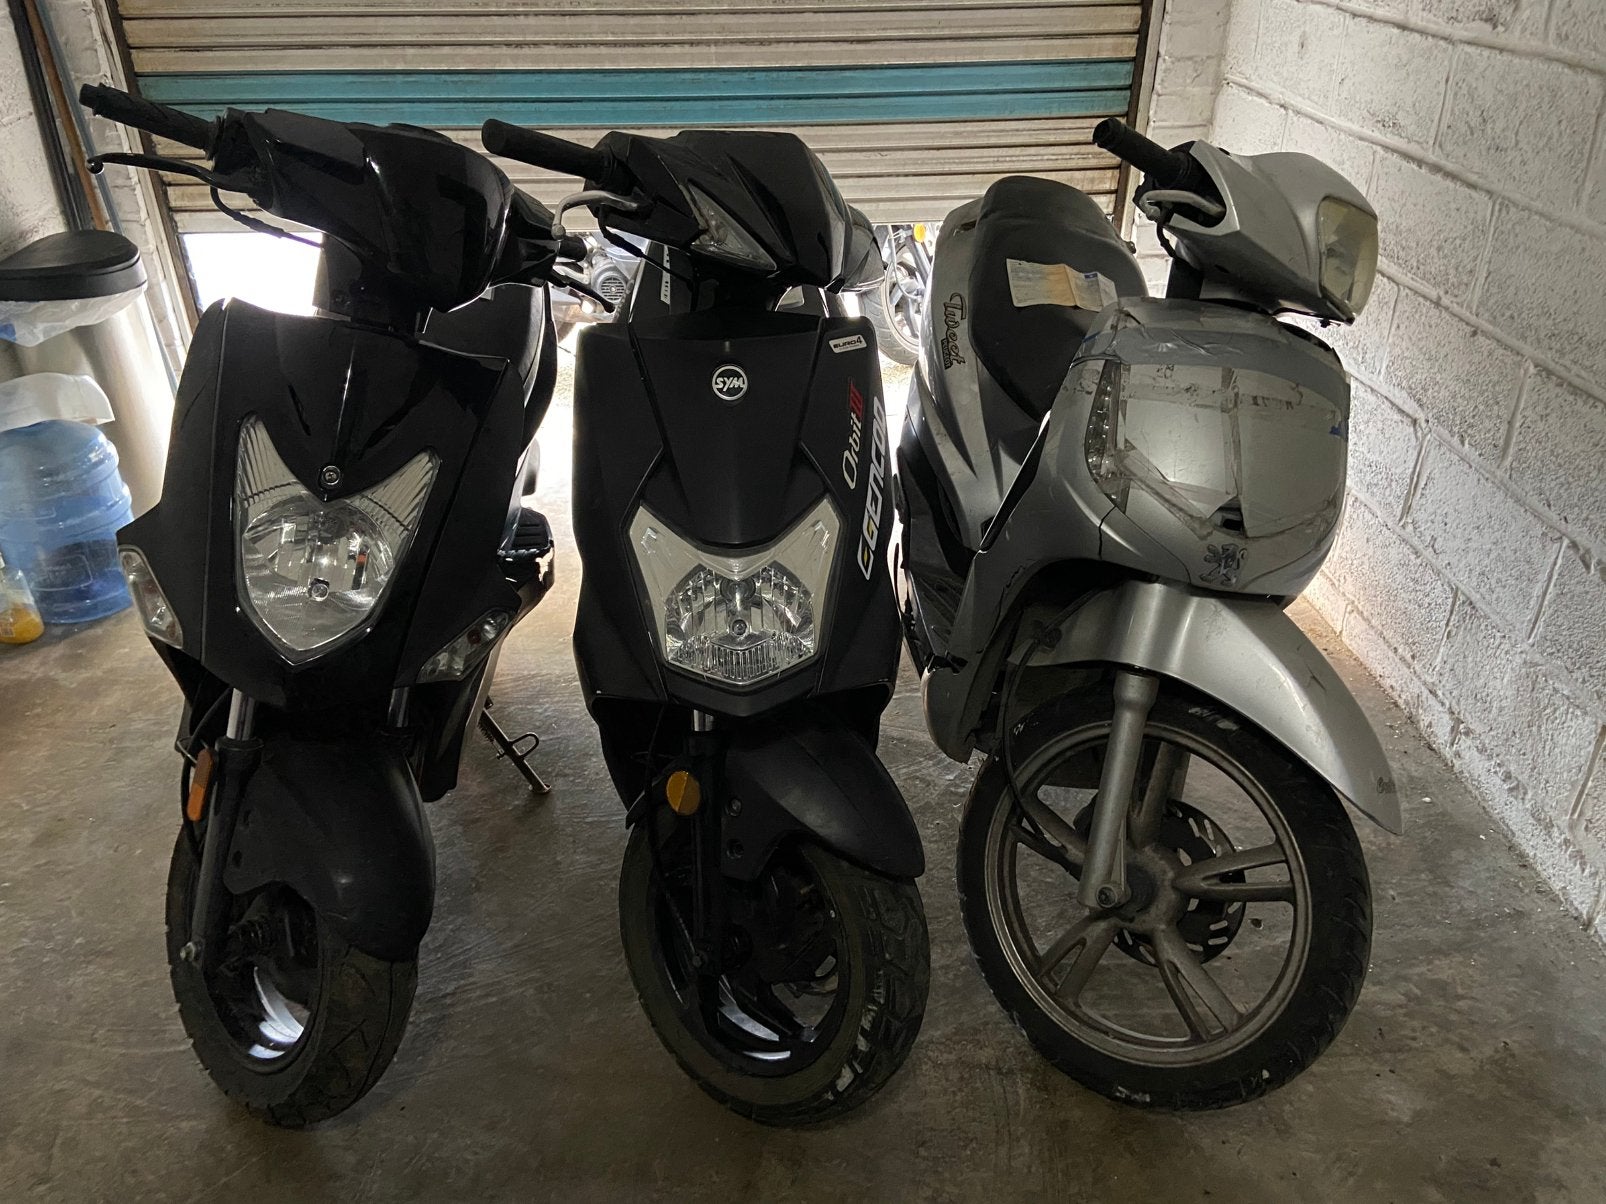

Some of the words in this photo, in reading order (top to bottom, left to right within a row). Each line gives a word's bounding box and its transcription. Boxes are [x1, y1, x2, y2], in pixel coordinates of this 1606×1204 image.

[943, 292, 967, 365] Tweet
[715, 376, 745, 392] SYM
[842, 412, 862, 490] Orbit
